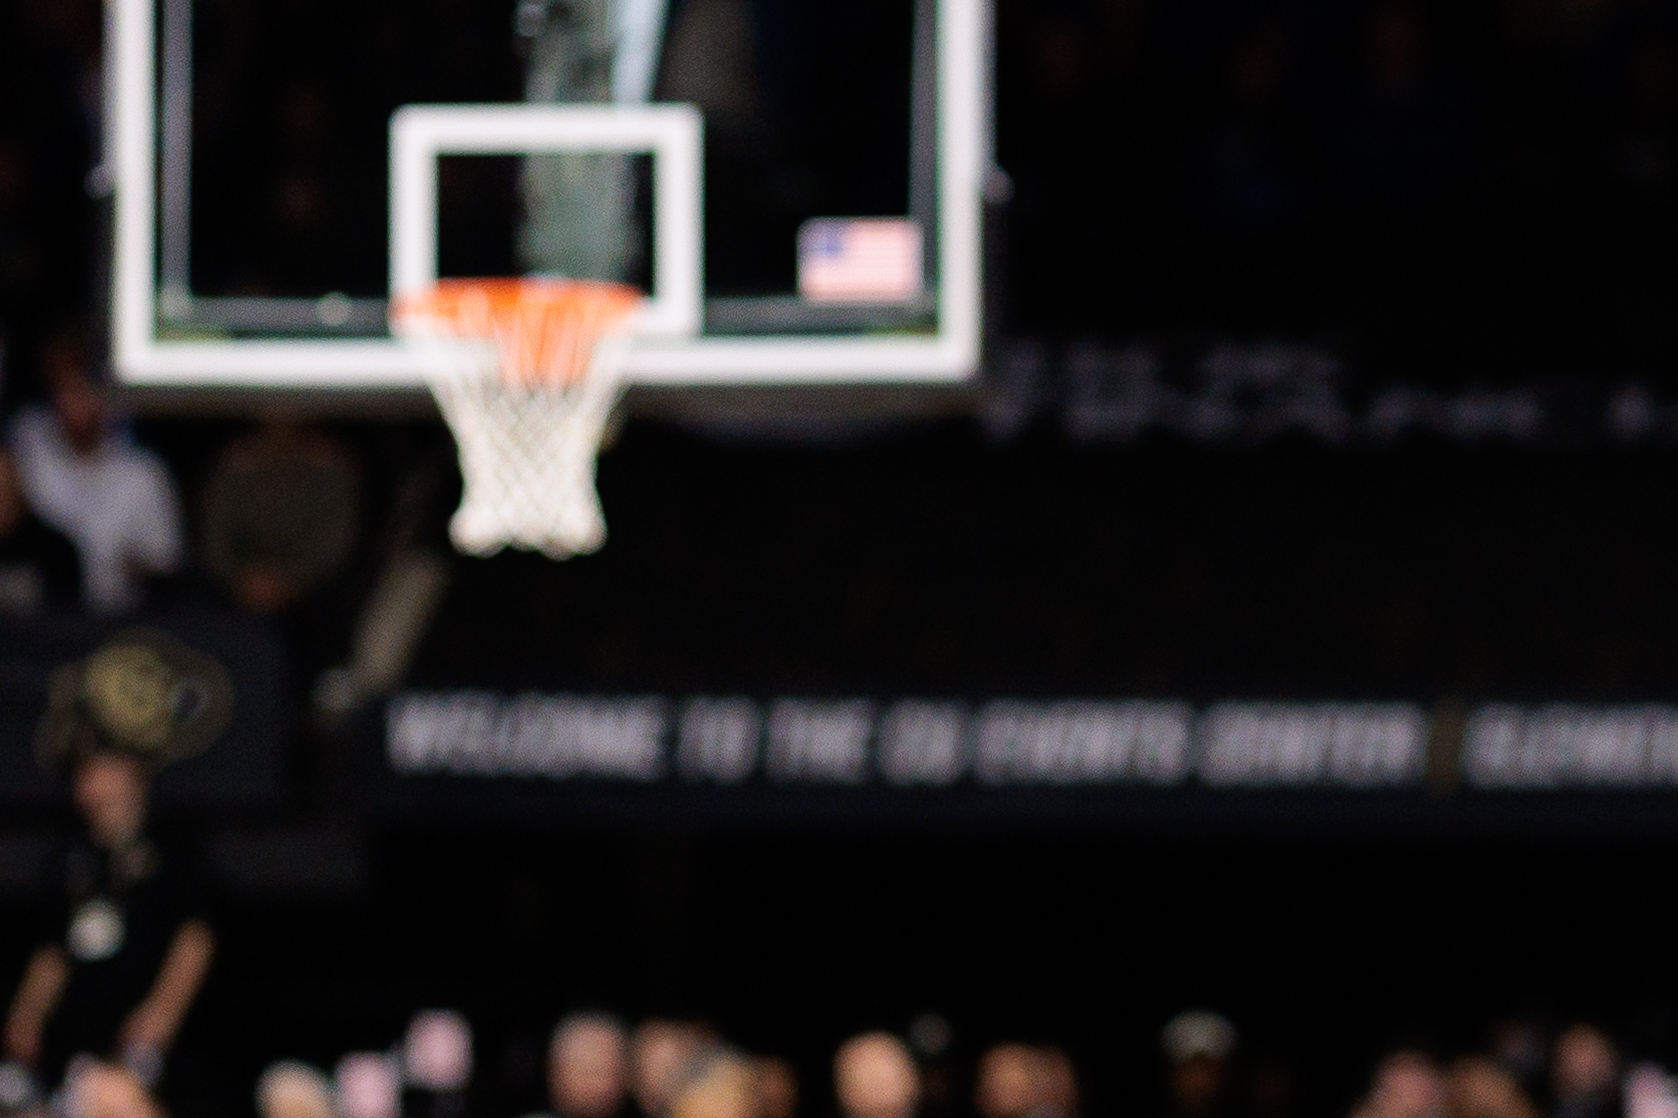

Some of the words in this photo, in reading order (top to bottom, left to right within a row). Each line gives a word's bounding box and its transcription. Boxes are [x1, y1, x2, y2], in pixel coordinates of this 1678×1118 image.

[386, 692, 662, 775] WELCOME
[677, 695, 756, 778] TO
[766, 696, 868, 778] THE
